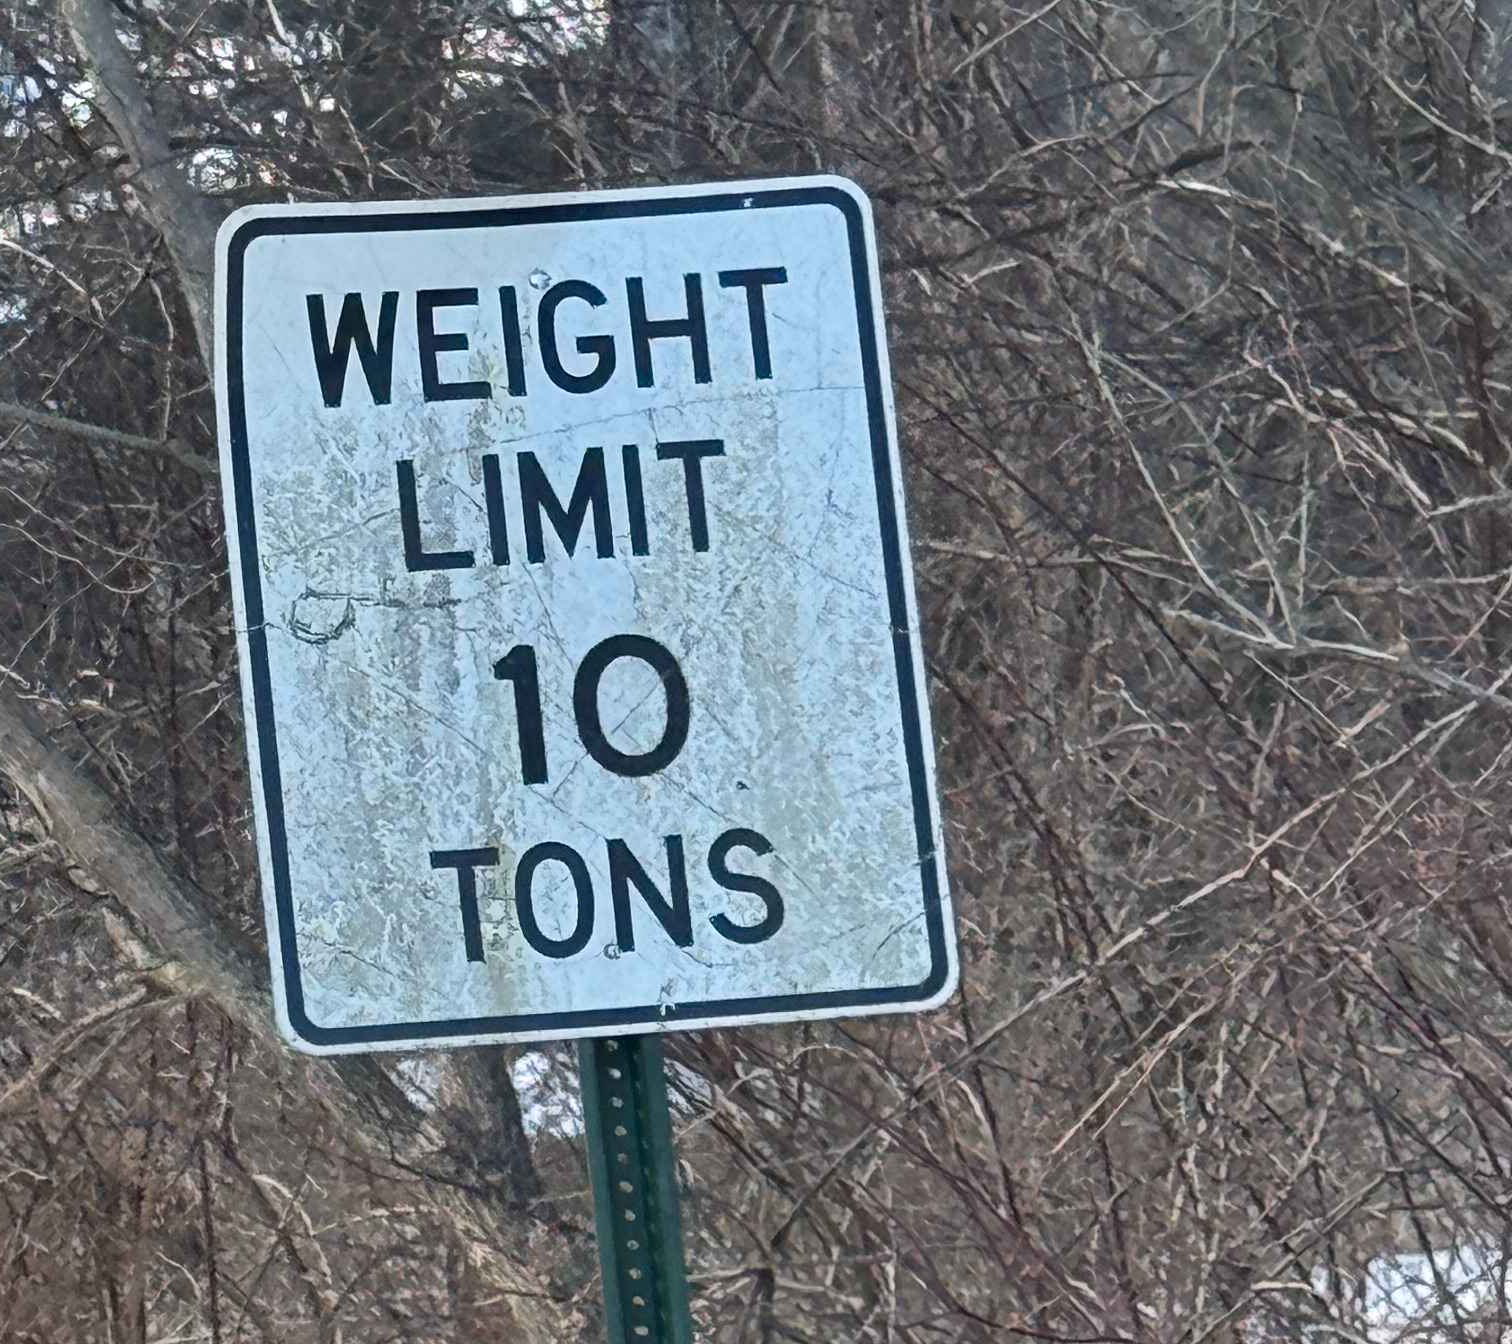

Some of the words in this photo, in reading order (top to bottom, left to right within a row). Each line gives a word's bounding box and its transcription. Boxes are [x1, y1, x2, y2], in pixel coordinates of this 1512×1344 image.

[306, 267, 787, 408] WEIGHT
[396, 439, 727, 572] LIMIT
[492, 633, 690, 786] 10
[429, 827, 785, 963] TONS
